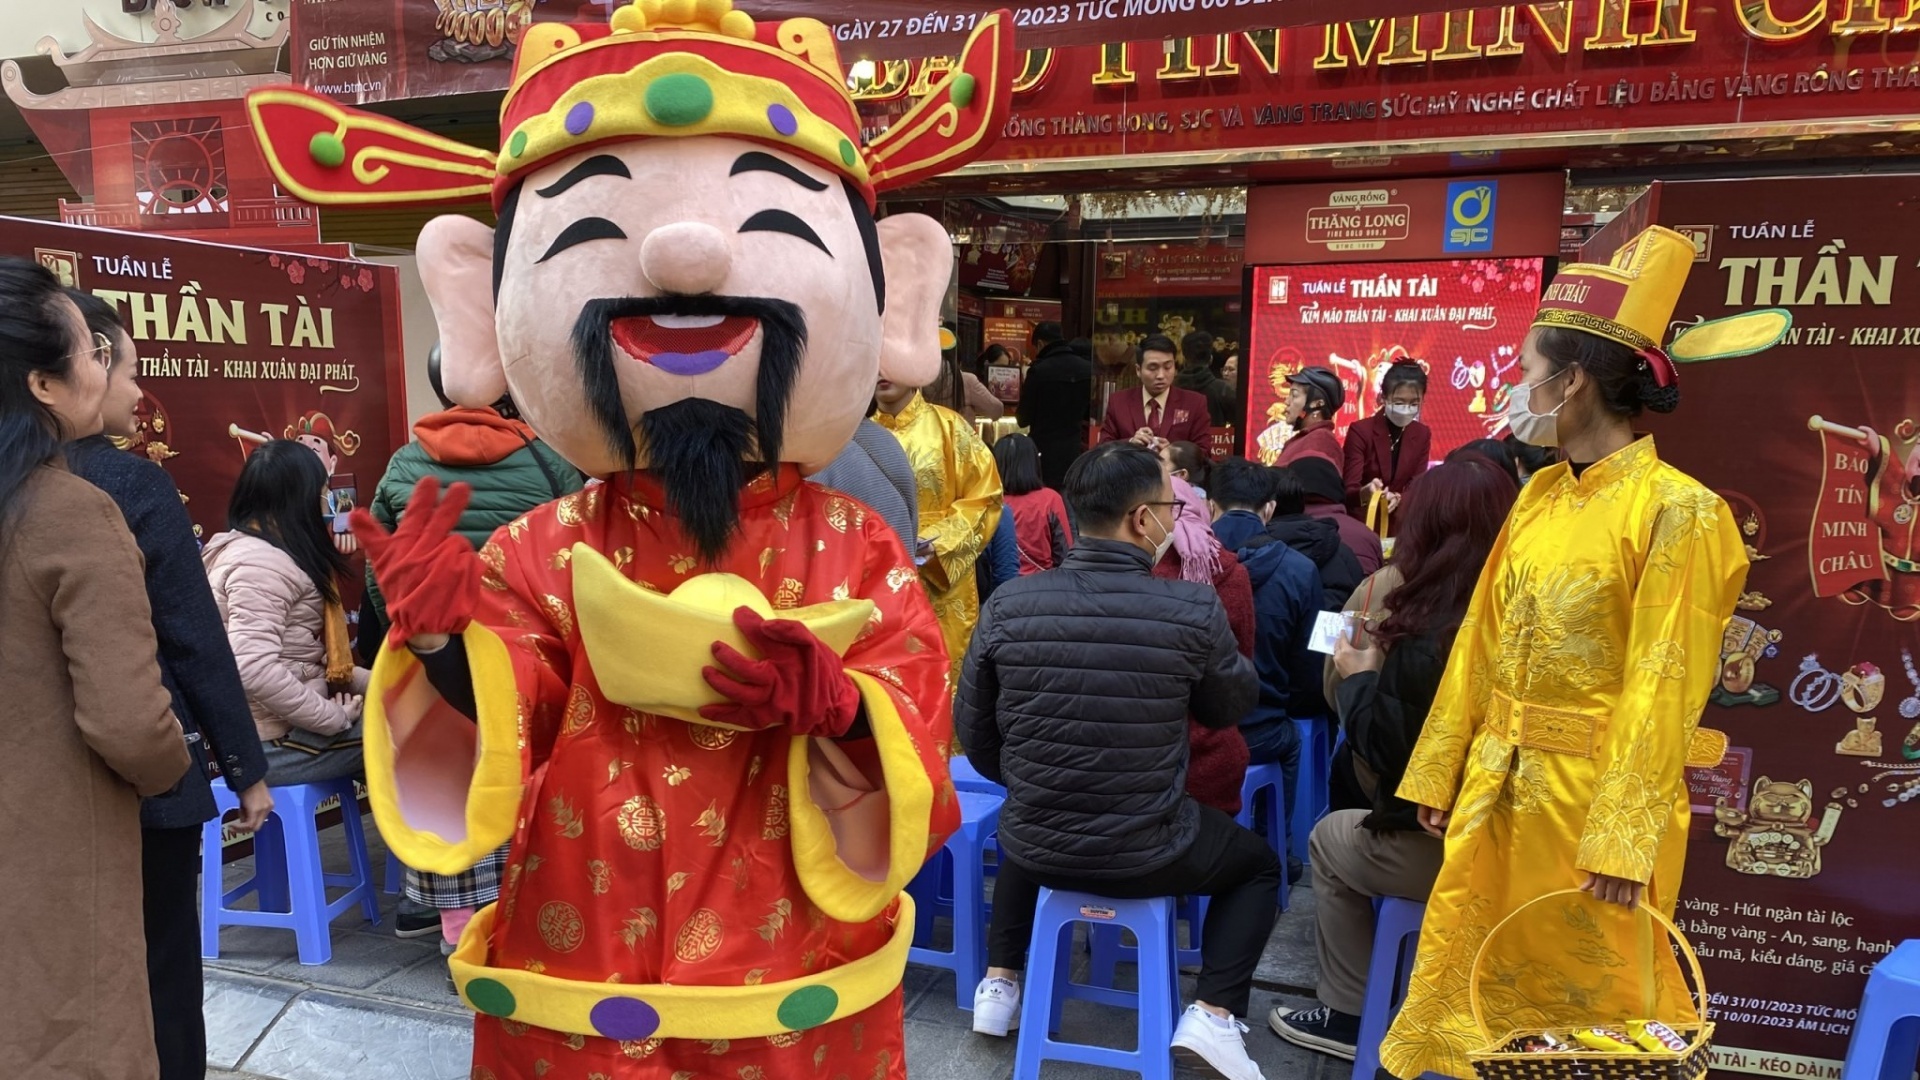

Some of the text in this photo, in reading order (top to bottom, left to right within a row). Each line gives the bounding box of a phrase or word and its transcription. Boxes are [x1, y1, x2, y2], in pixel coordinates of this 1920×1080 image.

[833, 20, 875, 41] GÀY
[878, 19, 902, 38] 27
[906, 11, 949, 36] ĐẾN
[952, 5, 1070, 32] 31//2023
[309, 32, 386, 52] GIỮ TÍN NHIỆM
[309, 49, 387, 71] HƠN GIỮ VÀNG
[314, 80, 382, 95] www.btmc.vn
[1050, 111, 1112, 136] THĂNG
[1180, 108, 1213, 130] SJC
[1310, 101, 1377, 122] TRANG
[1381, 93, 1422, 118] SỨC
[1427, 90, 1460, 116] MỸ
[1466, 85, 1526, 116] NGHỆ
[1531, 79, 1590, 110] CHẤT
[1595, 78, 1644, 109] LIỆU
[1650, 71, 1716, 102] BẰNG
[1724, 70, 1788, 98] VÀNG
[1332, 192, 1358, 203] VÀNG
[1309, 213, 1406, 230] THĂNG LONG
[1729, 219, 1815, 239] TUẦN LỄ
[1450, 228, 1488, 247] SJC
[92, 254, 147, 279] TUẦN
[151, 257, 173, 281] LỄ
[1718, 239, 1899, 306] THẦN
[1302, 280, 1332, 294] TUẦN
[1350, 272, 1402, 298] THẦN
[1407, 274, 1438, 297] TÀI
[1558, 279, 1592, 304] CHÂU
[92, 280, 336, 349] THẦN TÀI
[1301, 308, 1320, 324] KIM
[1344, 303, 1370, 323] THẦN
[1371, 305, 1387, 323] TÀI
[1394, 308, 1418, 322] KHAI
[1420, 306, 1446, 322] XUÂN
[1447, 307, 1466, 325] ĐẠI
[1467, 303, 1495, 321] PHÁT
[1806, 321, 1835, 346] TÀI
[1850, 327, 1898, 346] KHAI
[140, 347, 182, 378] THẦN
[186, 353, 209, 378] TÀI
[223, 360, 257, 379] KHAI
[260, 357, 296, 380] XUÂN
[300, 362, 321, 384] ĐẠI
[324, 358, 356, 381] PHÁT
[1834, 450, 1869, 474] BẢO
[1835, 484, 1864, 505] TÍN
[1822, 521, 1868, 538] MINH
[1819, 550, 1874, 576] CHÂU
[1684, 897, 1720, 916] vàng
[1733, 902, 1761, 917] Hút
[1766, 906, 1802, 923] ngàn
[1806, 909, 1825, 924] tài
[1831, 911, 1853, 928] lộc
[1690, 919, 1727, 940] bằng
[1731, 925, 1767, 944] vàng
[1781, 931, 1807, 947] An,
[1812, 935, 1851, 953] sang,
[1856, 936, 1895, 956] hạnh
[1718, 947, 1746, 964] mã,
[1750, 948, 1782, 965] kiểu
[1786, 952, 1828, 972] dáng,
[1832, 957, 1855, 975] giá
[1732, 995, 1803, 1015] 31/01/2023
[1806, 1003, 1833, 1018] TỨC
[1723, 1010, 1794, 1029] 10/01/2023
[1795, 1015, 1818, 1032] ÂM
[1819, 1020, 1851, 1036] LỊCH
[1723, 1049, 1747, 1068] TÀI
[1759, 1053, 1791, 1074] KÉO
[1795, 1057, 1824, 1078] DÀI
